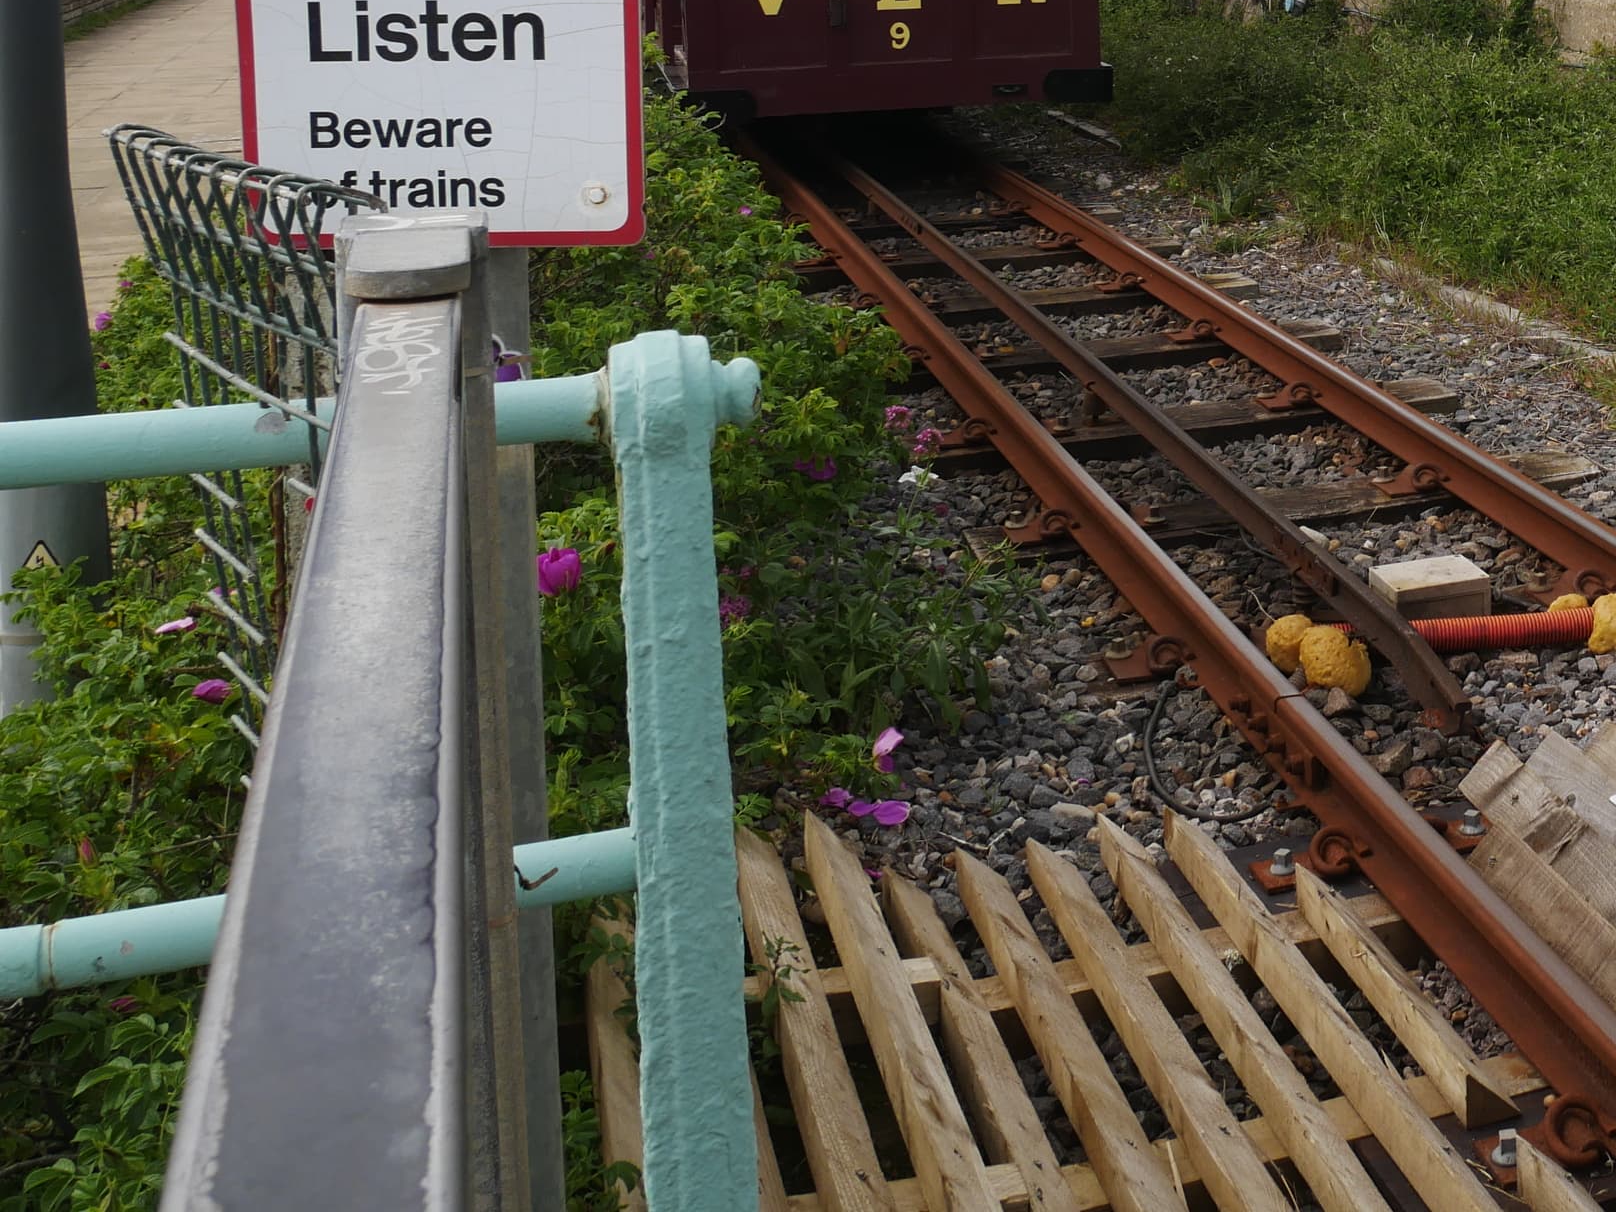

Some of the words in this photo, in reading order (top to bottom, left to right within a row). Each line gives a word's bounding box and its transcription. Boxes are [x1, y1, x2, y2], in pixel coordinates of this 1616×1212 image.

[307, 0, 546, 63] Listen
[889, 22, 911, 50] 9
[309, 111, 493, 149] Beware
[369, 170, 506, 208] trains
